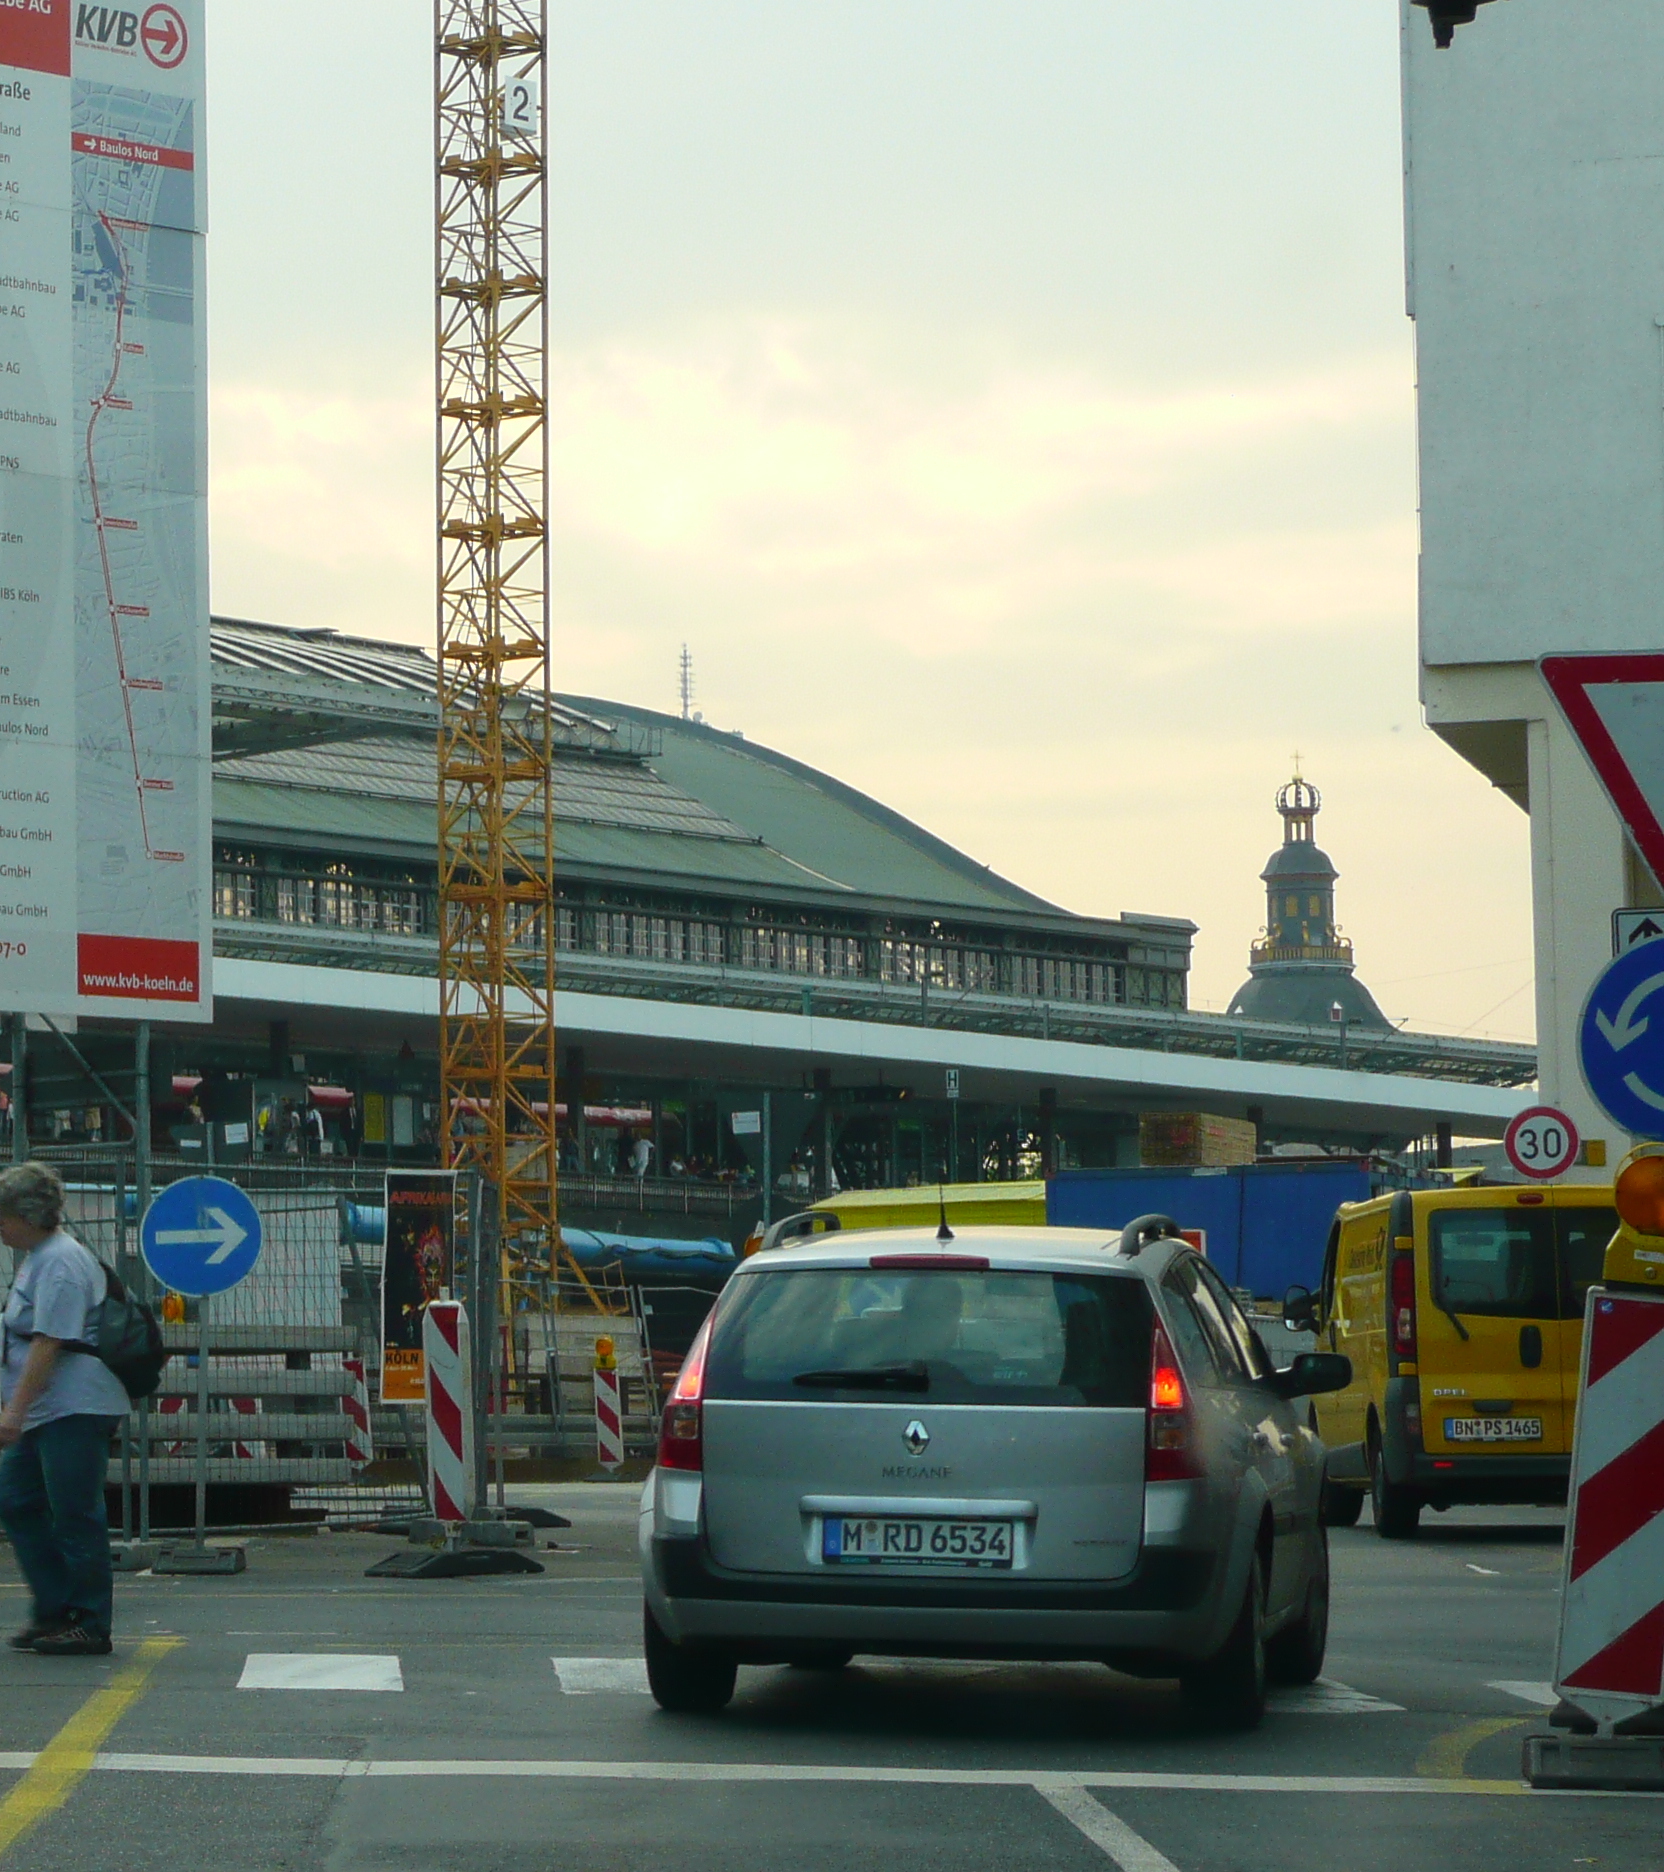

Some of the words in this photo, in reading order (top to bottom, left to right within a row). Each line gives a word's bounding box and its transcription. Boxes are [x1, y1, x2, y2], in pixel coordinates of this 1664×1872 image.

[75, 3, 139, 47] KVB
[512, 85, 529, 122] 2
[100, 140, 132, 158] Baulos
[135, 146, 159, 161] Nord
[4, 180, 20, 194] AG
[4, 210, 20, 222] AG
[10, 305, 25, 319] AG
[6, 361, 20, 375] AG
[0, 455, 20, 470] PNS
[0, 587, 15, 601] IBS
[18, 590, 40, 603] Köln
[13, 693, 40, 707] Essen
[25, 723, 49, 737] Nord
[35, 791, 50, 804] AG
[20, 827, 52, 842] GmbH
[0, 864, 31, 879] GmbH
[16, 903, 48, 918] GmbH
[83, 972, 194, 993] www.kvb-koeln.de
[1519, 1127, 1562, 1160] 30
[386, 1350, 419, 1365] KÖLN
[1454, 1420, 1474, 1435] BN
[1484, 1420, 1502, 1436] PS
[1505, 1420, 1540, 1436] 1465
[844, 1522, 862, 1551] M
[883, 1523, 923, 1553] RD
[930, 1524, 1006, 1556] 6534
